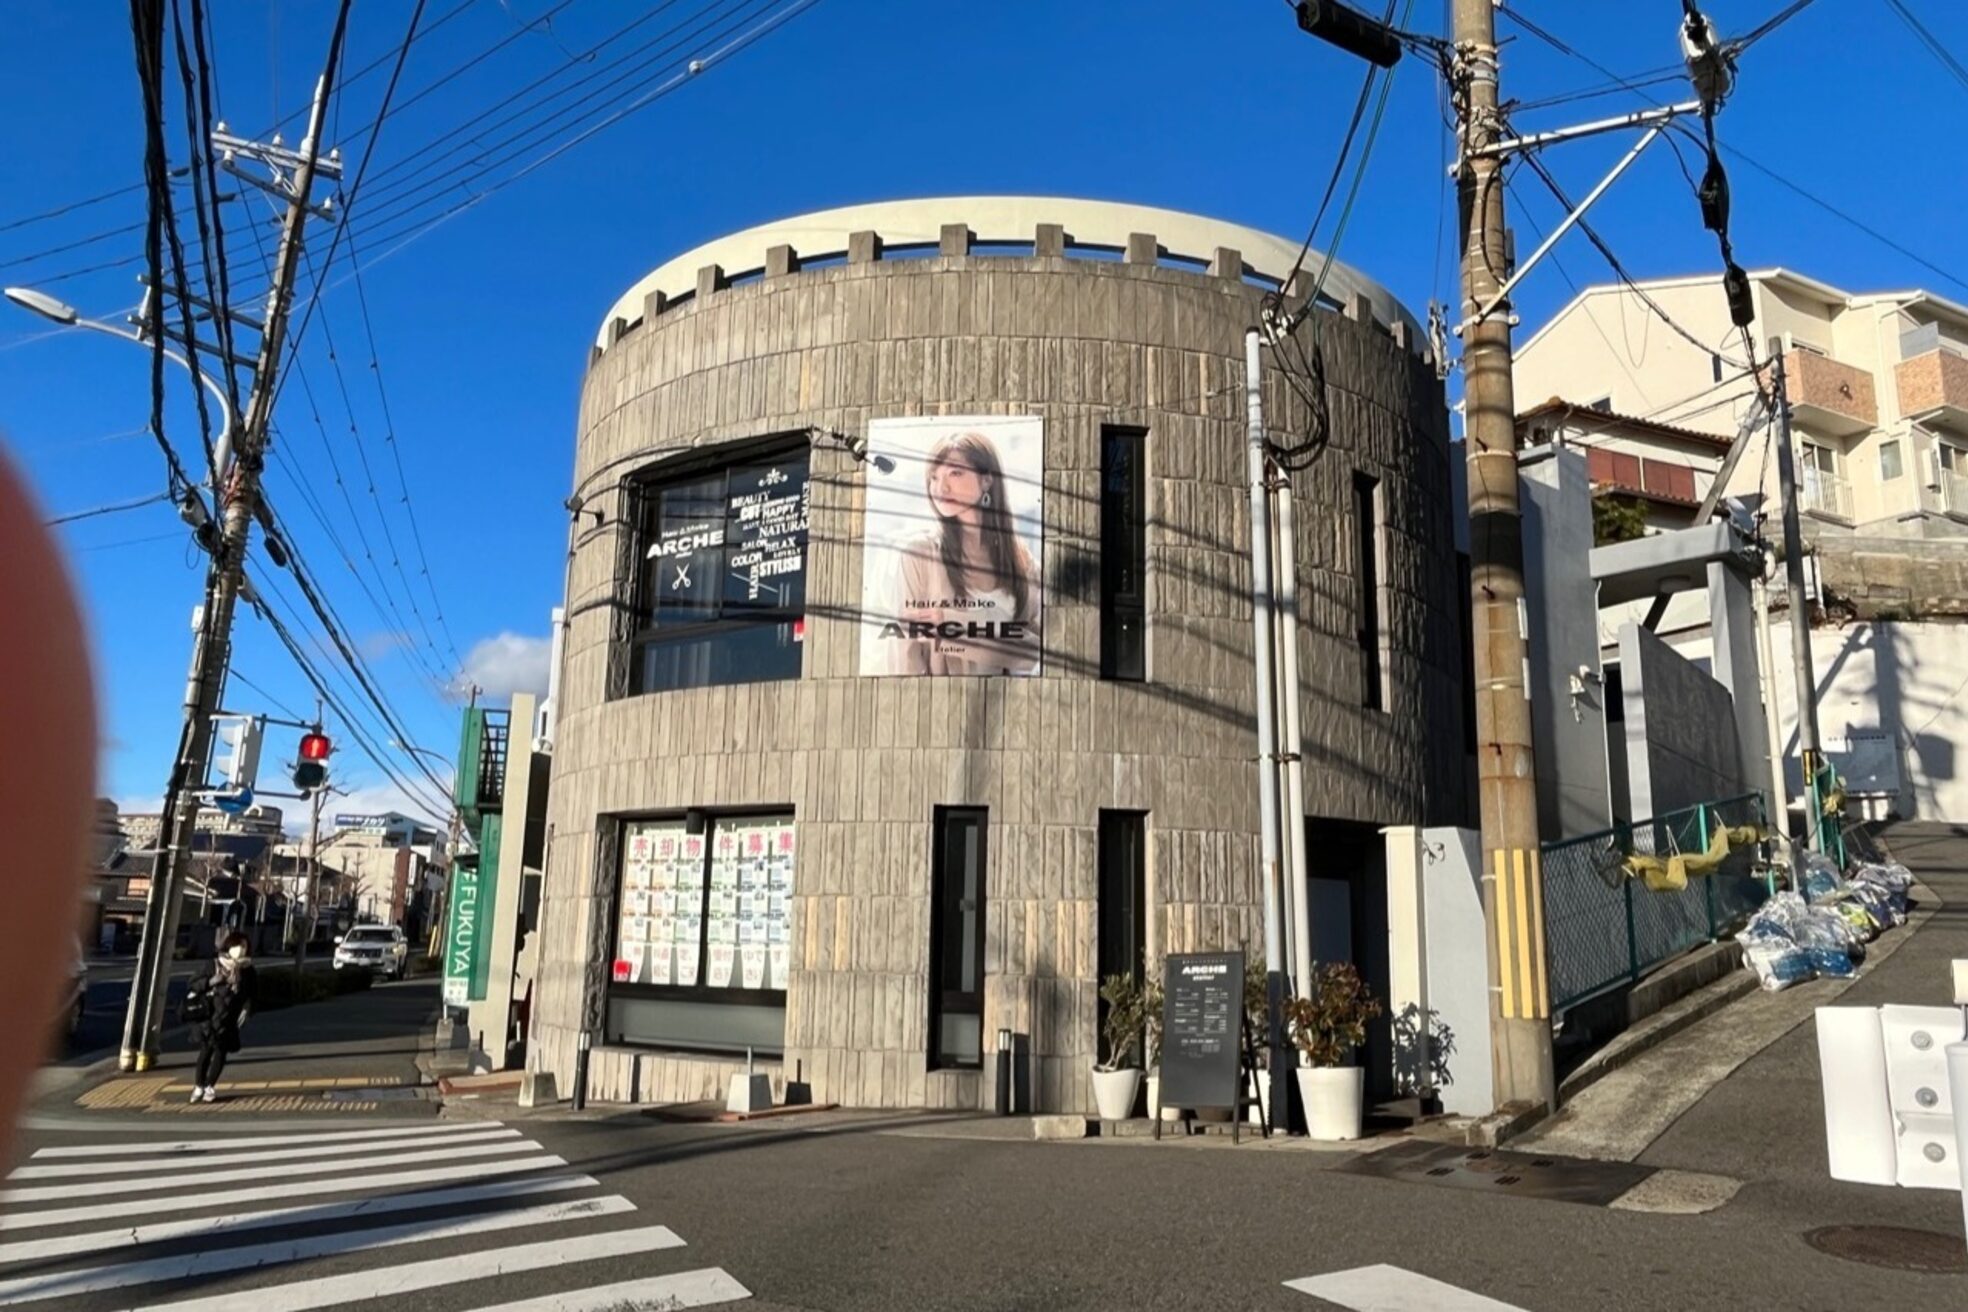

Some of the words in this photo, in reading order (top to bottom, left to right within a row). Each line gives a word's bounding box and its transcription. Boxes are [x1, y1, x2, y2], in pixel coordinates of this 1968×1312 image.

[731, 490, 771, 509] BEAUTY
[740, 504, 761, 521] CUT
[763, 503, 796, 520] HAPPY
[646, 530, 724, 559] ARCHE
[764, 536, 797, 553] RELAX
[731, 552, 763, 568] COLOR
[759, 555, 802, 577] STYLISH
[877, 620, 1029, 640] ARCHE
[453, 886, 477, 974] FUKUYA
[1181, 965, 1227, 975] ARCHE
